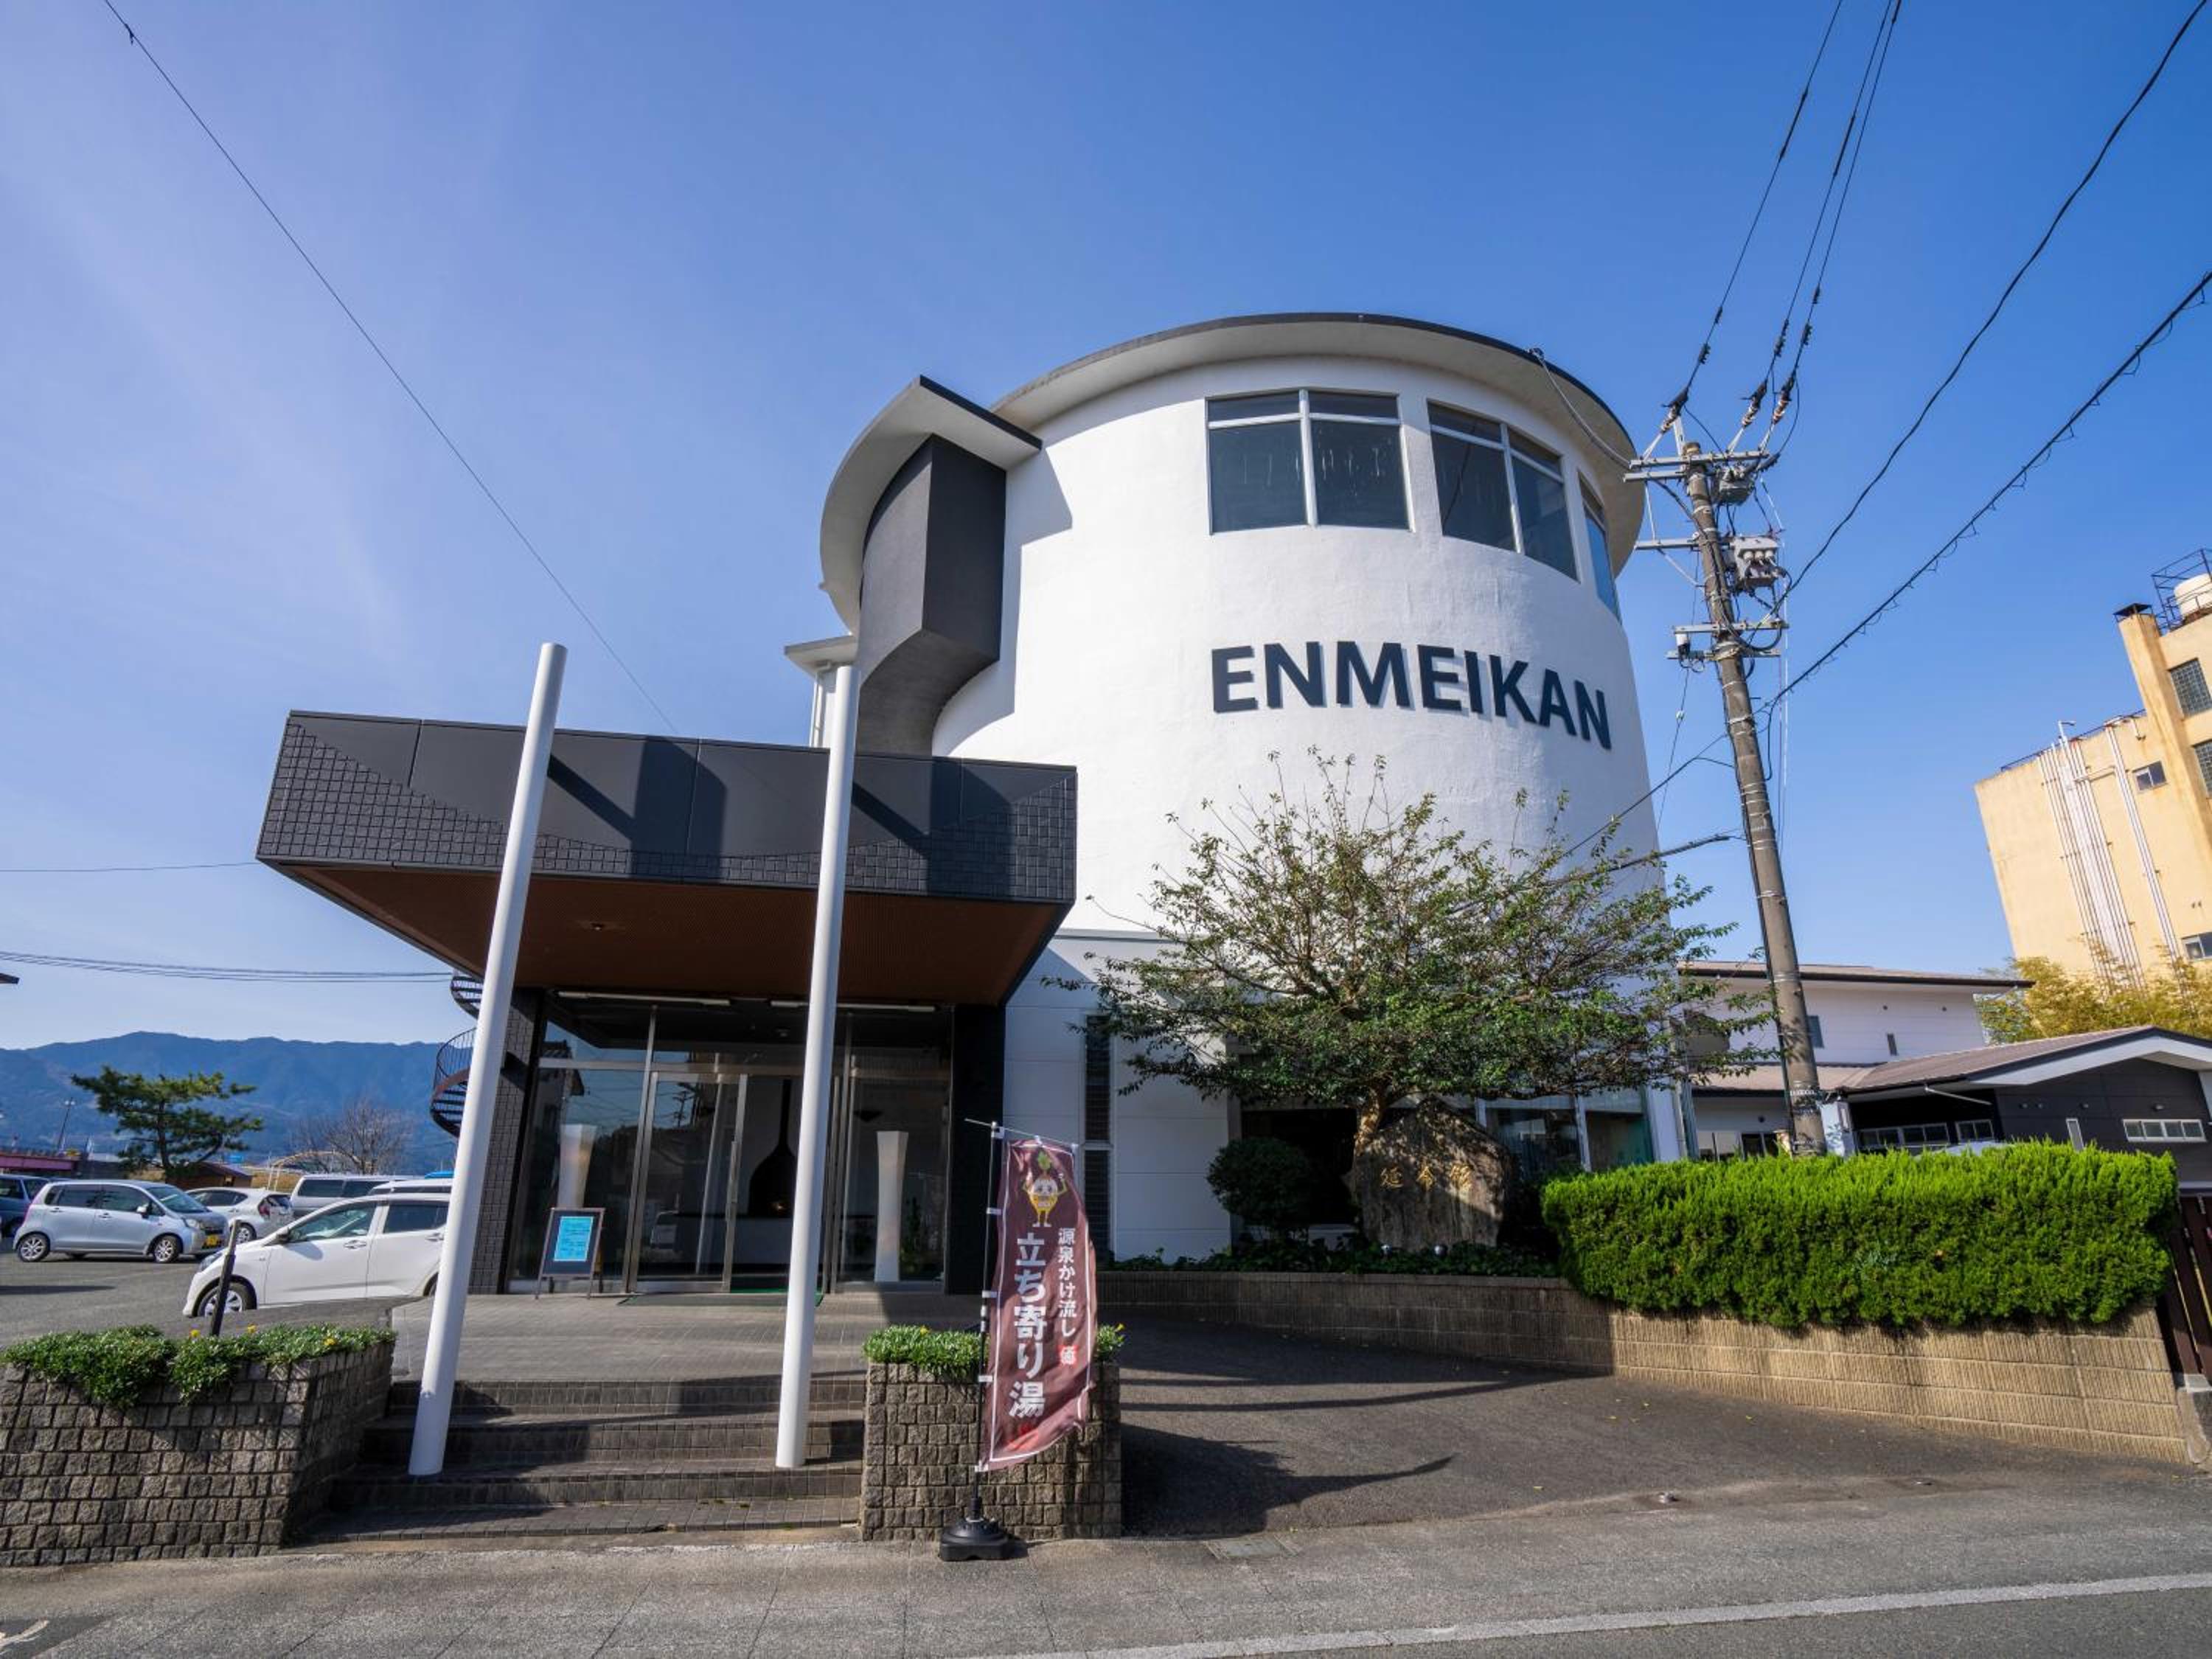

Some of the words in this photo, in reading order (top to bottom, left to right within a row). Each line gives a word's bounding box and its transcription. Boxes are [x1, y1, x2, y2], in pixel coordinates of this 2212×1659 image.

[1211, 640, 1612, 751] ENMEIKAN
[1009, 1232, 1047, 1418] 立ち寄り湯
[1058, 1228, 1077, 1338] 源泉かけ流し
